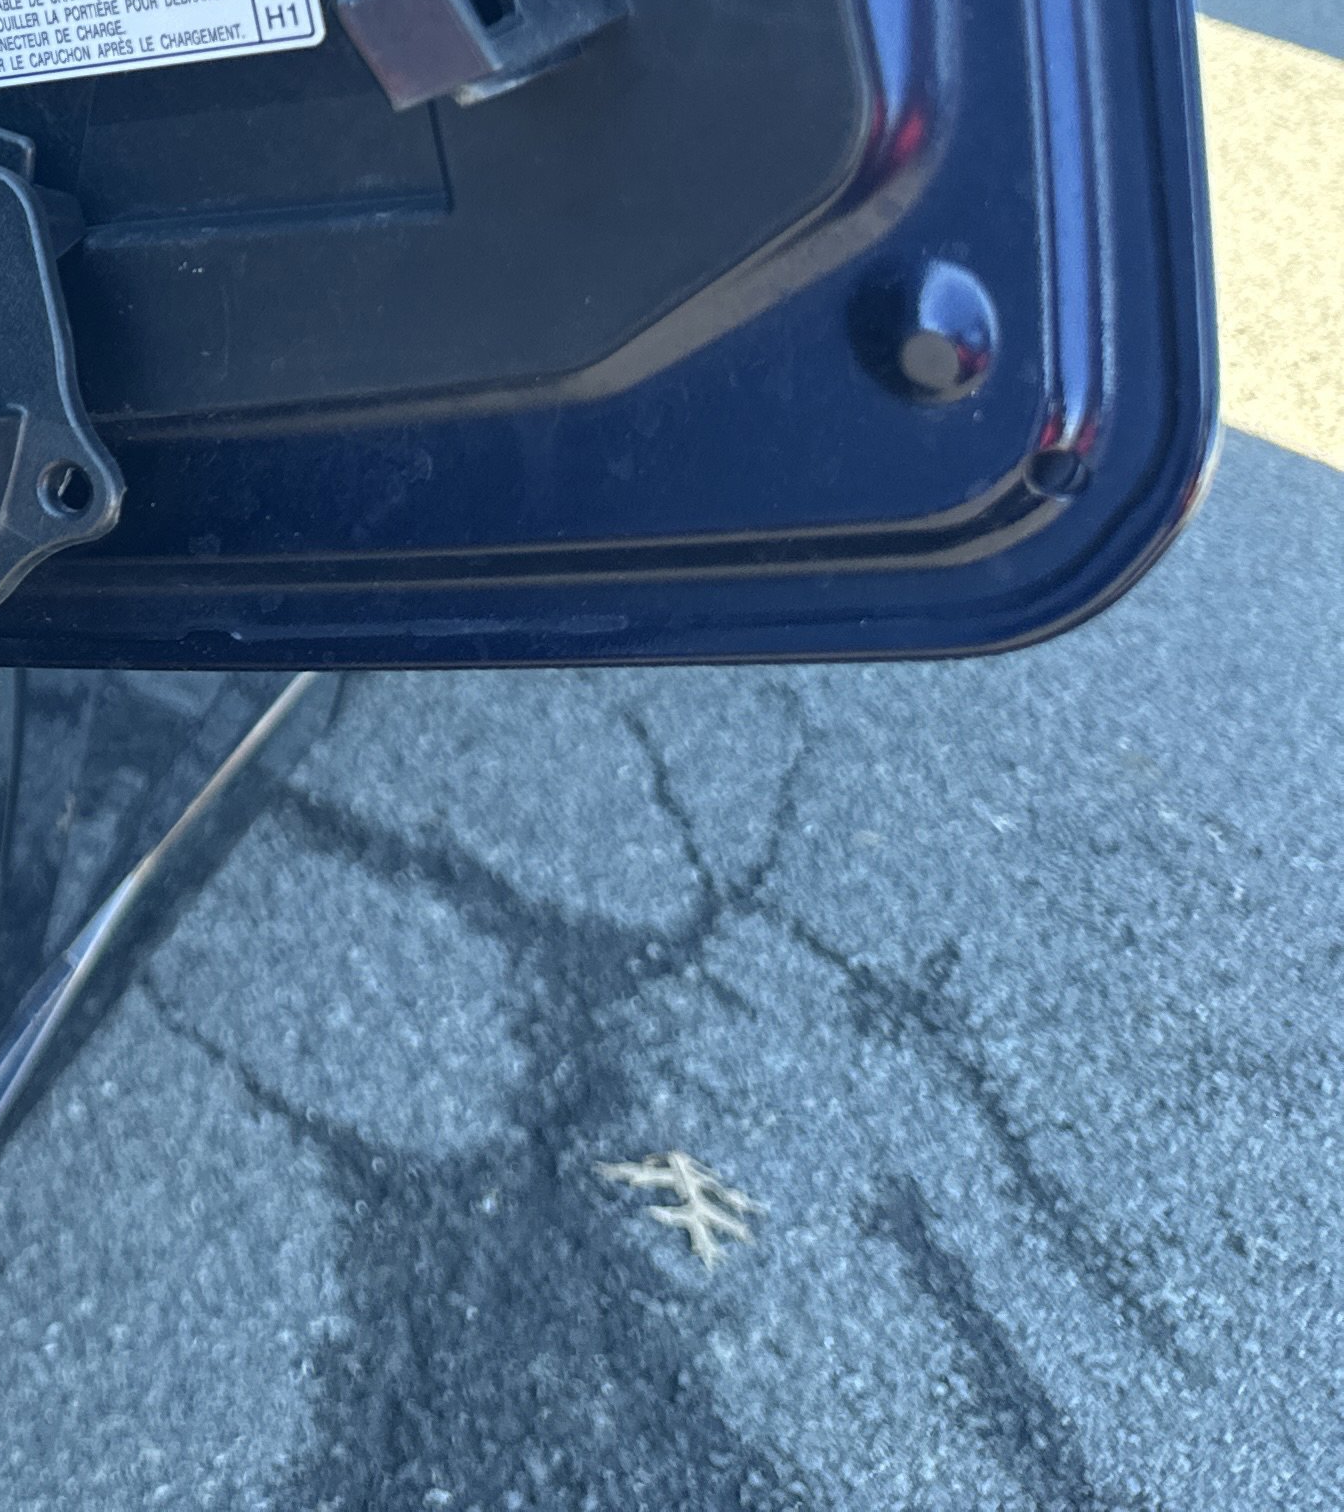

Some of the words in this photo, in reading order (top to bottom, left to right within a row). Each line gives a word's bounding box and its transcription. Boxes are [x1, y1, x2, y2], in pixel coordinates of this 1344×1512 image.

[44, 9, 60, 25] LA
[265, 3, 299, 30] H1
[54, 27, 72, 44] DE
[76, 19, 127, 41] CHARGE.
[10, 54, 24, 71] LE
[29, 45, 91, 68] CAPUCHON
[97, 36, 134, 58] APRÈS
[139, 35, 155, 53] LE
[160, 23, 246, 50] CHARGEMENT.
